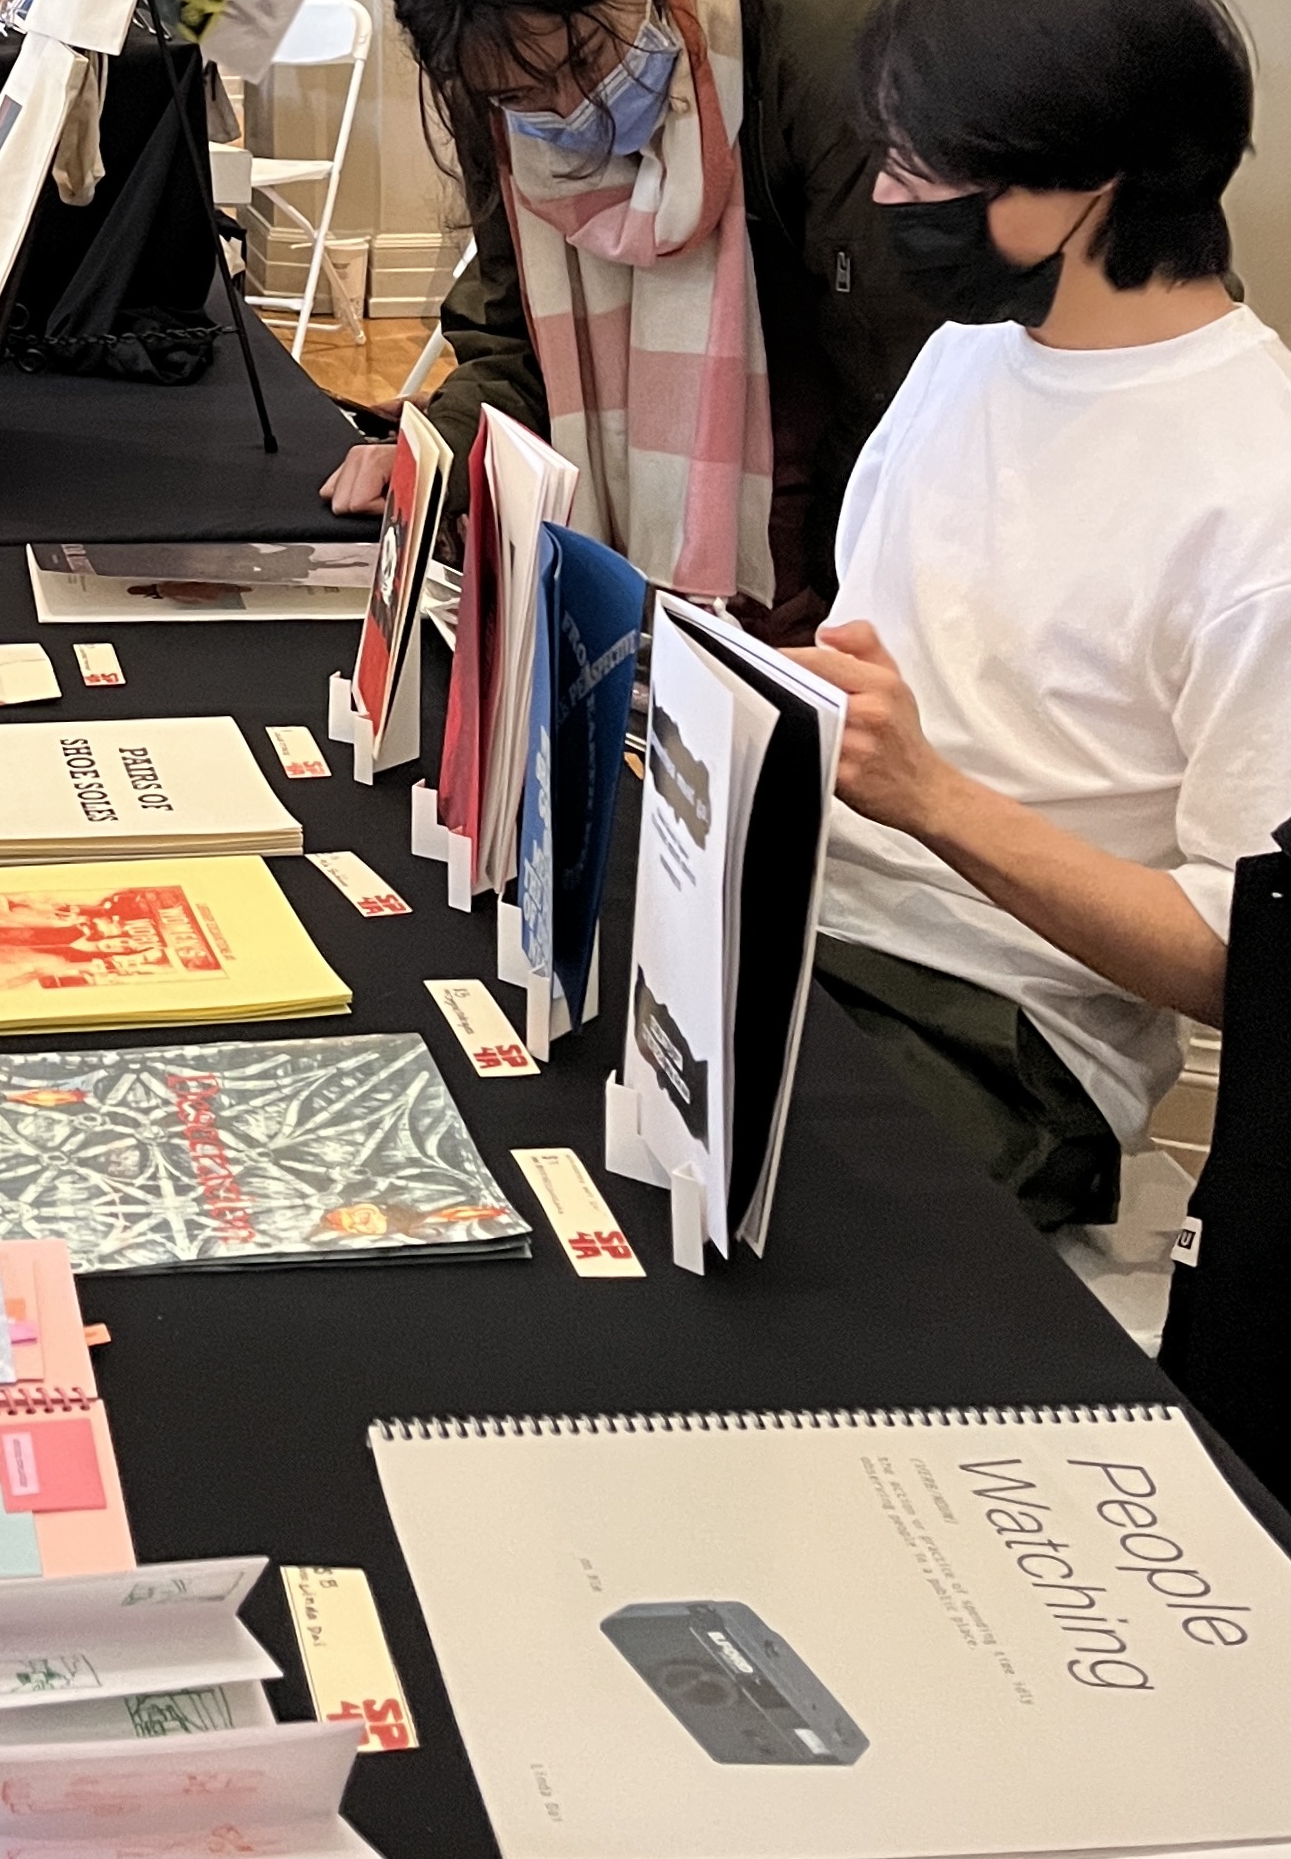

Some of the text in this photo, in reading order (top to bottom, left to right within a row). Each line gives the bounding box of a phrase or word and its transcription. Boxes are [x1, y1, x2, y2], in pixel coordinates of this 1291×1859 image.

[60, 738, 119, 823] SHOE SOLES
[118, 746, 174, 812] PAIRS OF
[595, 1231, 633, 1259] SP
[958, 1457, 1155, 1692] Watching
[1066, 1457, 1251, 1647] People
[361, 1698, 410, 1752] SP
